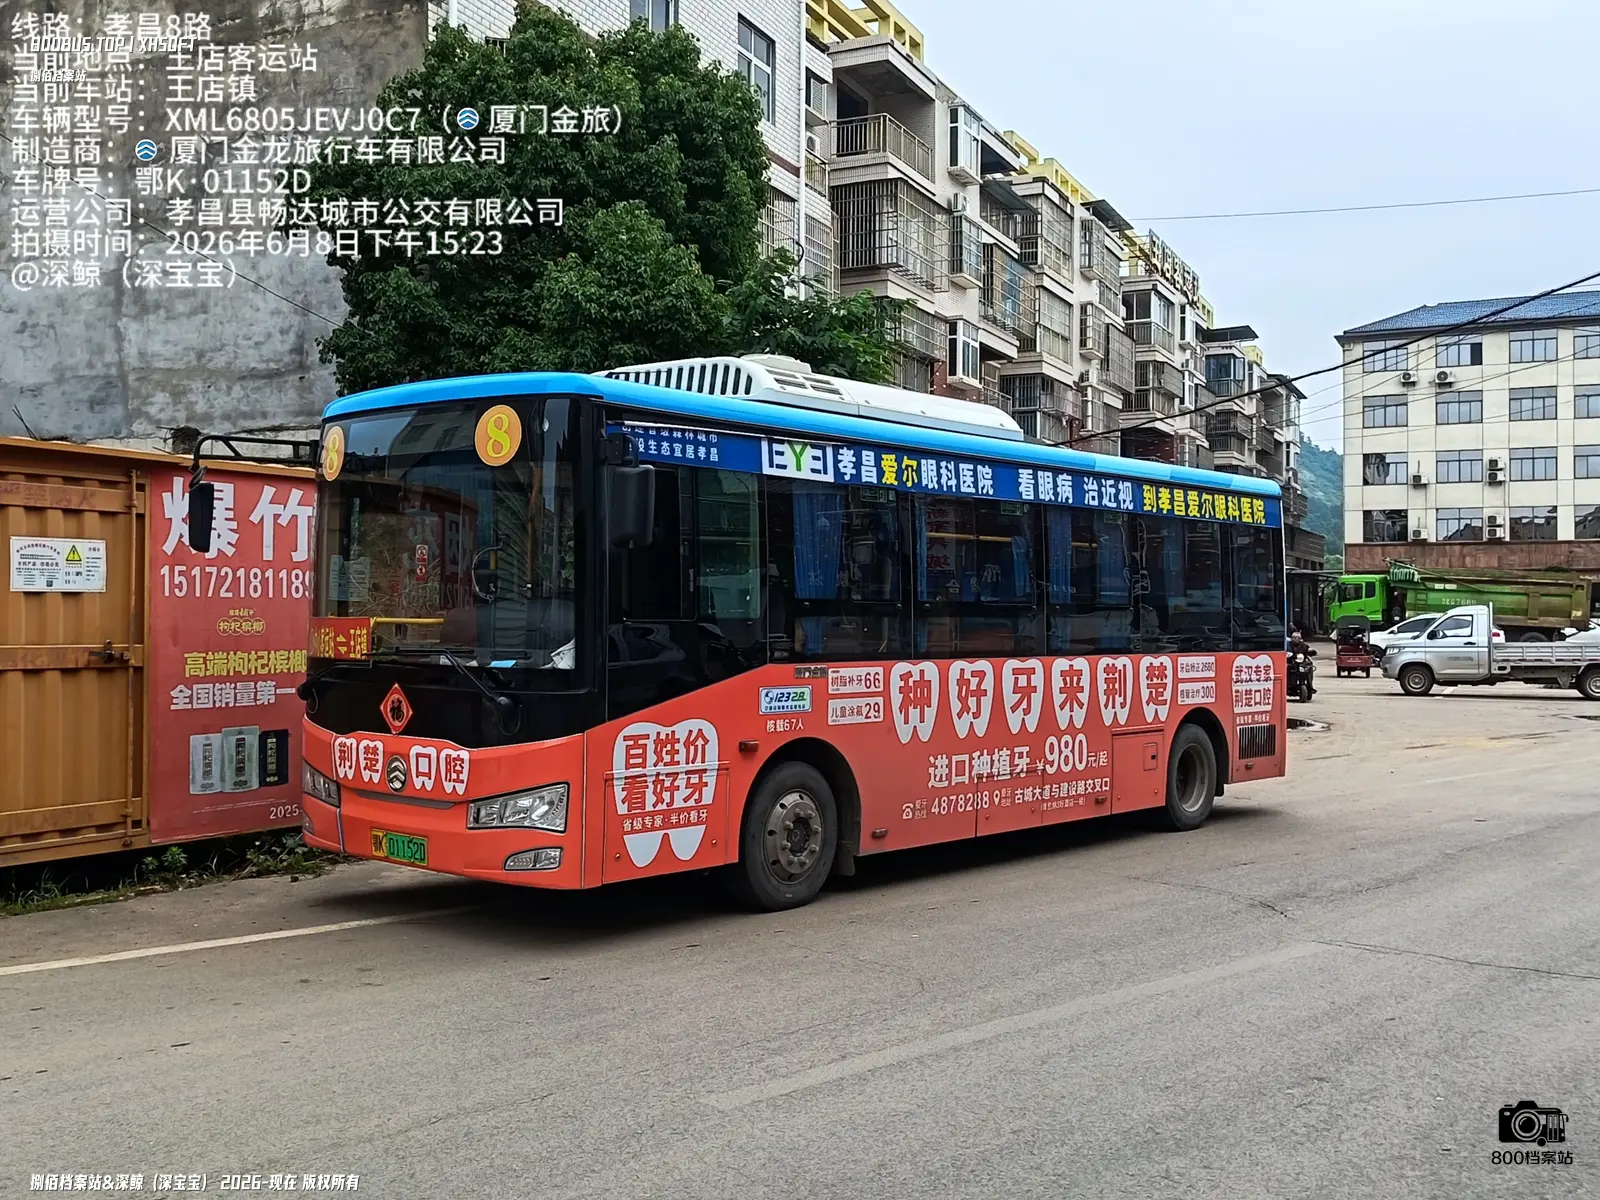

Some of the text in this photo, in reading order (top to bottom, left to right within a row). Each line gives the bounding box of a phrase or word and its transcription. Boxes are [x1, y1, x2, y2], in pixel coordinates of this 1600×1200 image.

[325, 435, 339, 473] 8
[487, 413, 511, 458] 8
[1018, 468, 1073, 505] 看眼病
[1083, 476, 1134, 509] 治近视
[1142, 484, 1266, 525] 到孝昌爱尔眼科医院
[184, 650, 307, 677] 高端枸杞槟榔
[1234, 665, 1272, 684] 武汉专家
[170, 681, 296, 710] 全国销量第一
[774, 691, 807, 703] 12328
[1234, 687, 1272, 708] 荆楚口腔
[337, 741, 465, 784] 荆楚 口腔
[622, 729, 710, 770] 百姓价
[928, 746, 1030, 789] 进口种植牙
[621, 768, 708, 813] 看好牙
[1015, 778, 1110, 804] 古城大道与建设路交叉口
